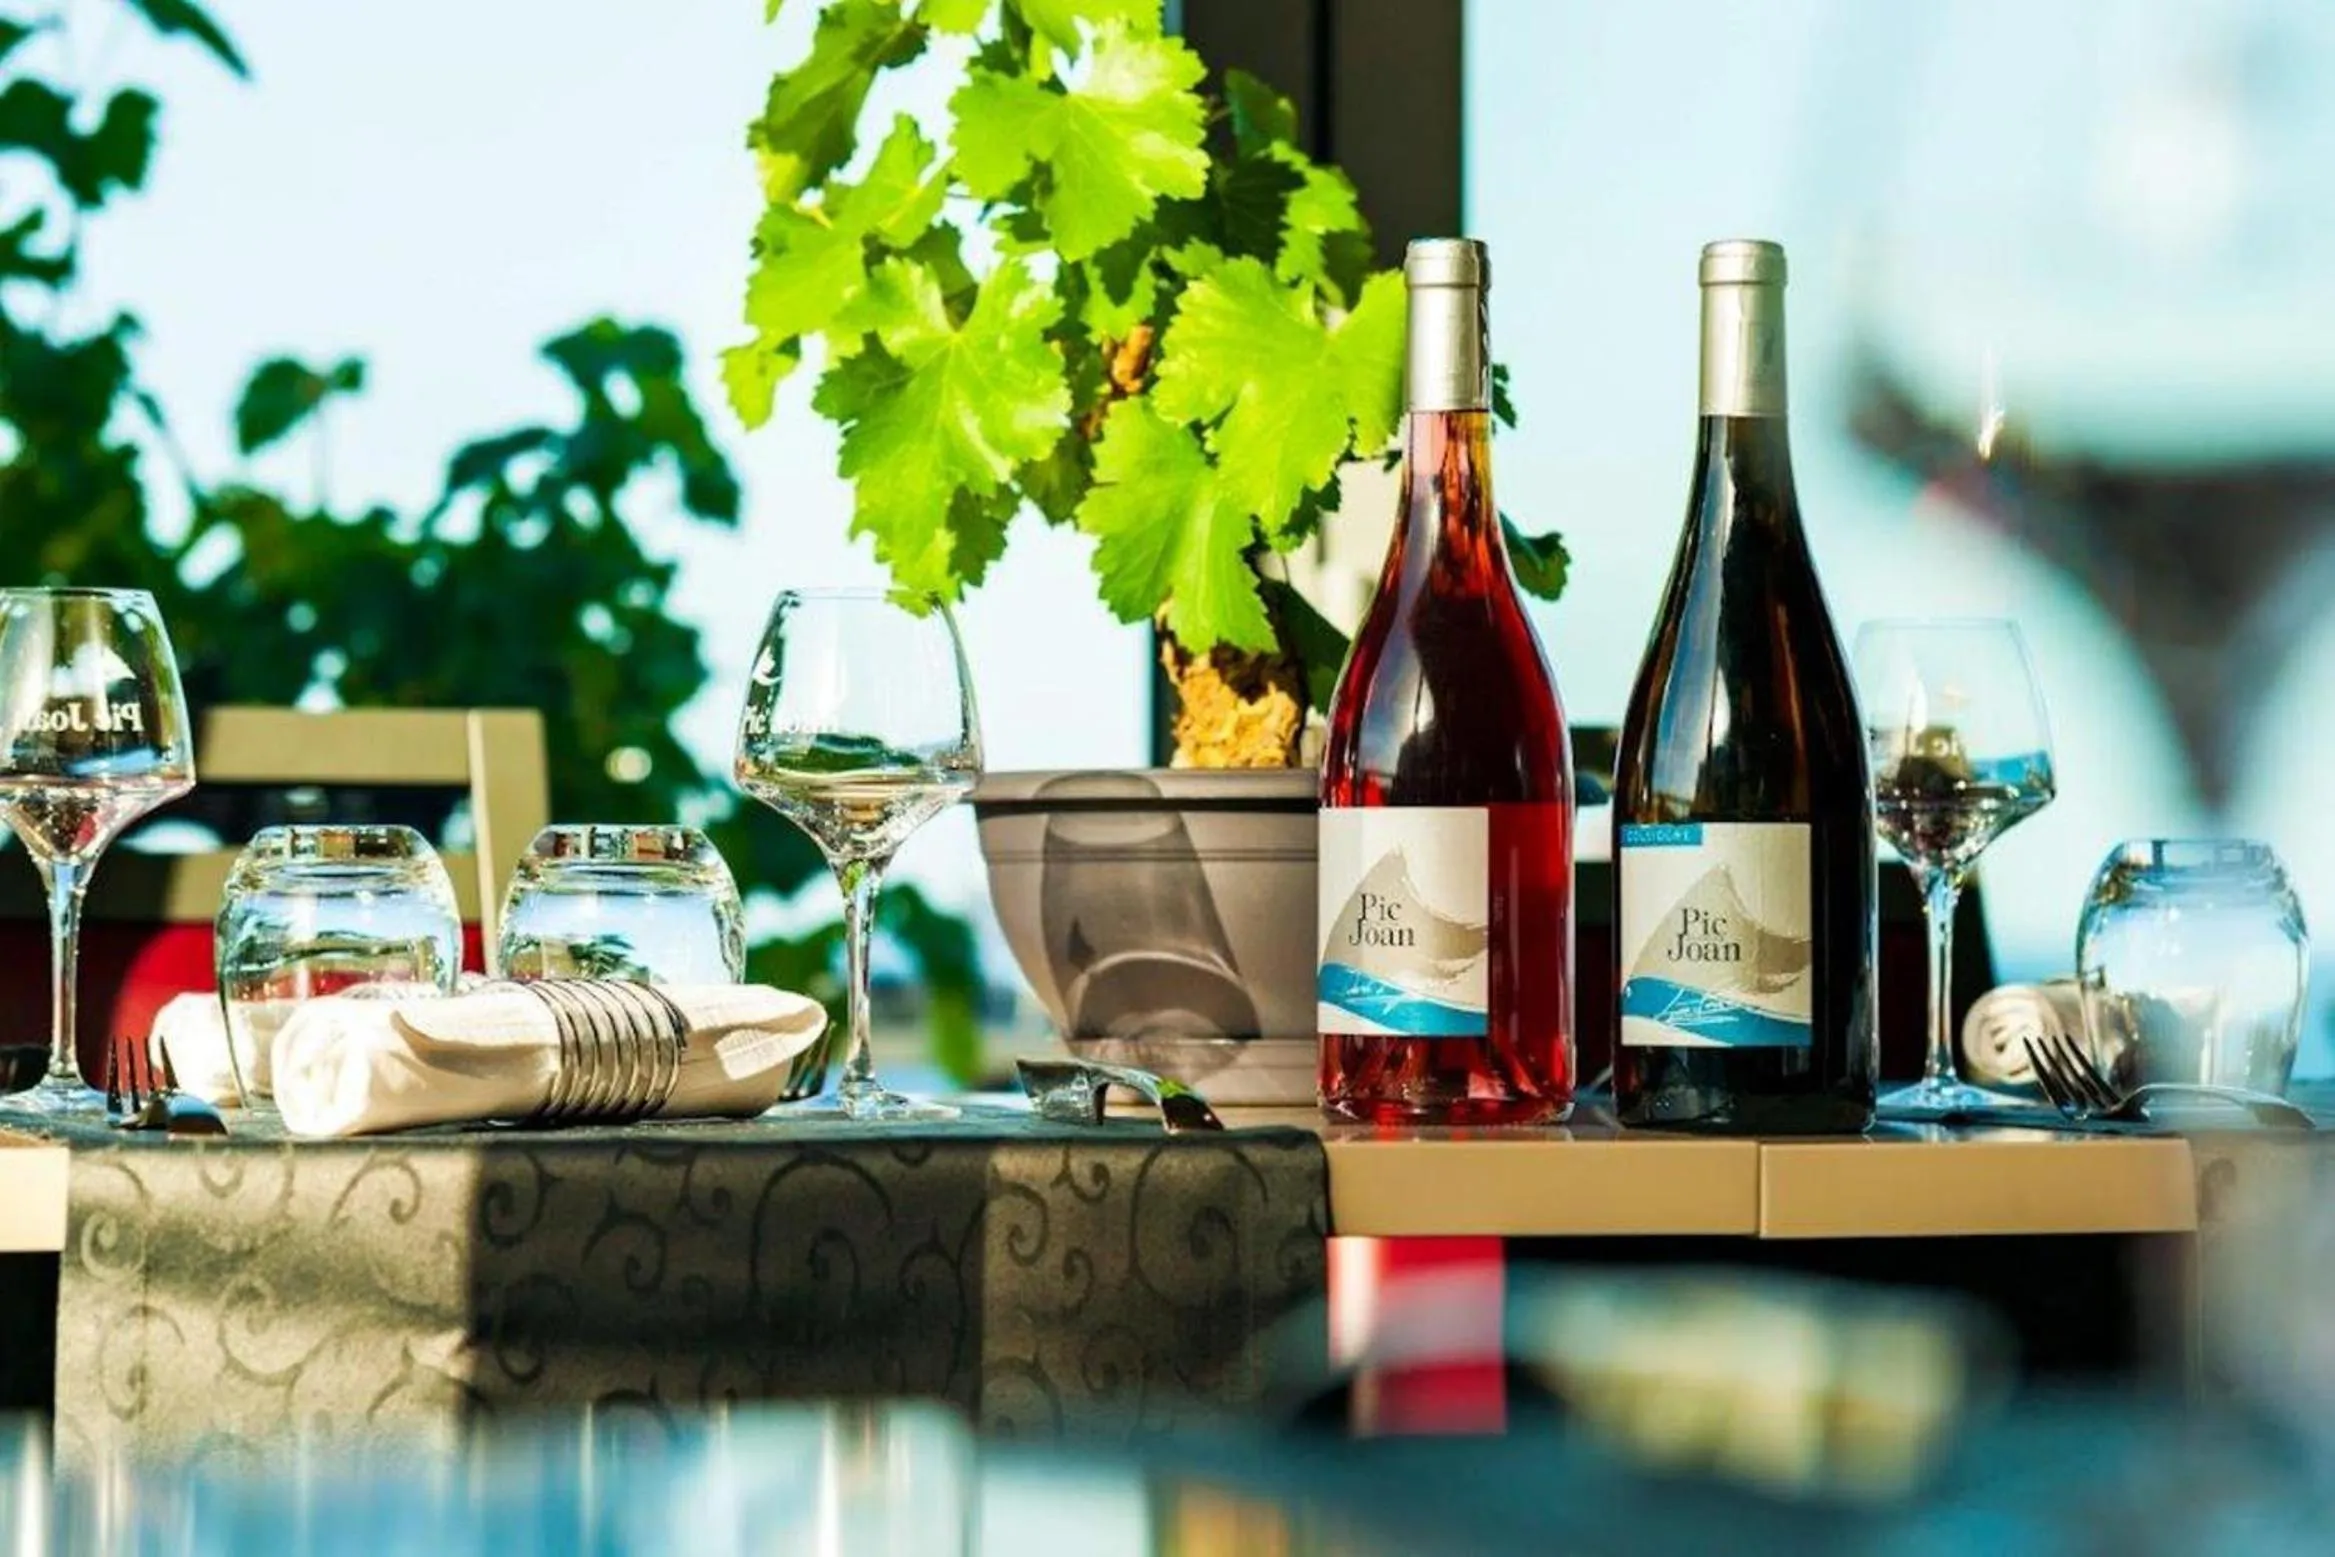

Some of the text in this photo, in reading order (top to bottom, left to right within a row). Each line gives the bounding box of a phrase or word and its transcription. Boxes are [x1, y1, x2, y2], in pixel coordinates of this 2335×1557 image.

[1361, 893, 1402, 920] Pic
[1349, 918, 1414, 946] Joan
[1682, 908, 1727, 935] Pic
[1667, 933, 1741, 961] Joan
